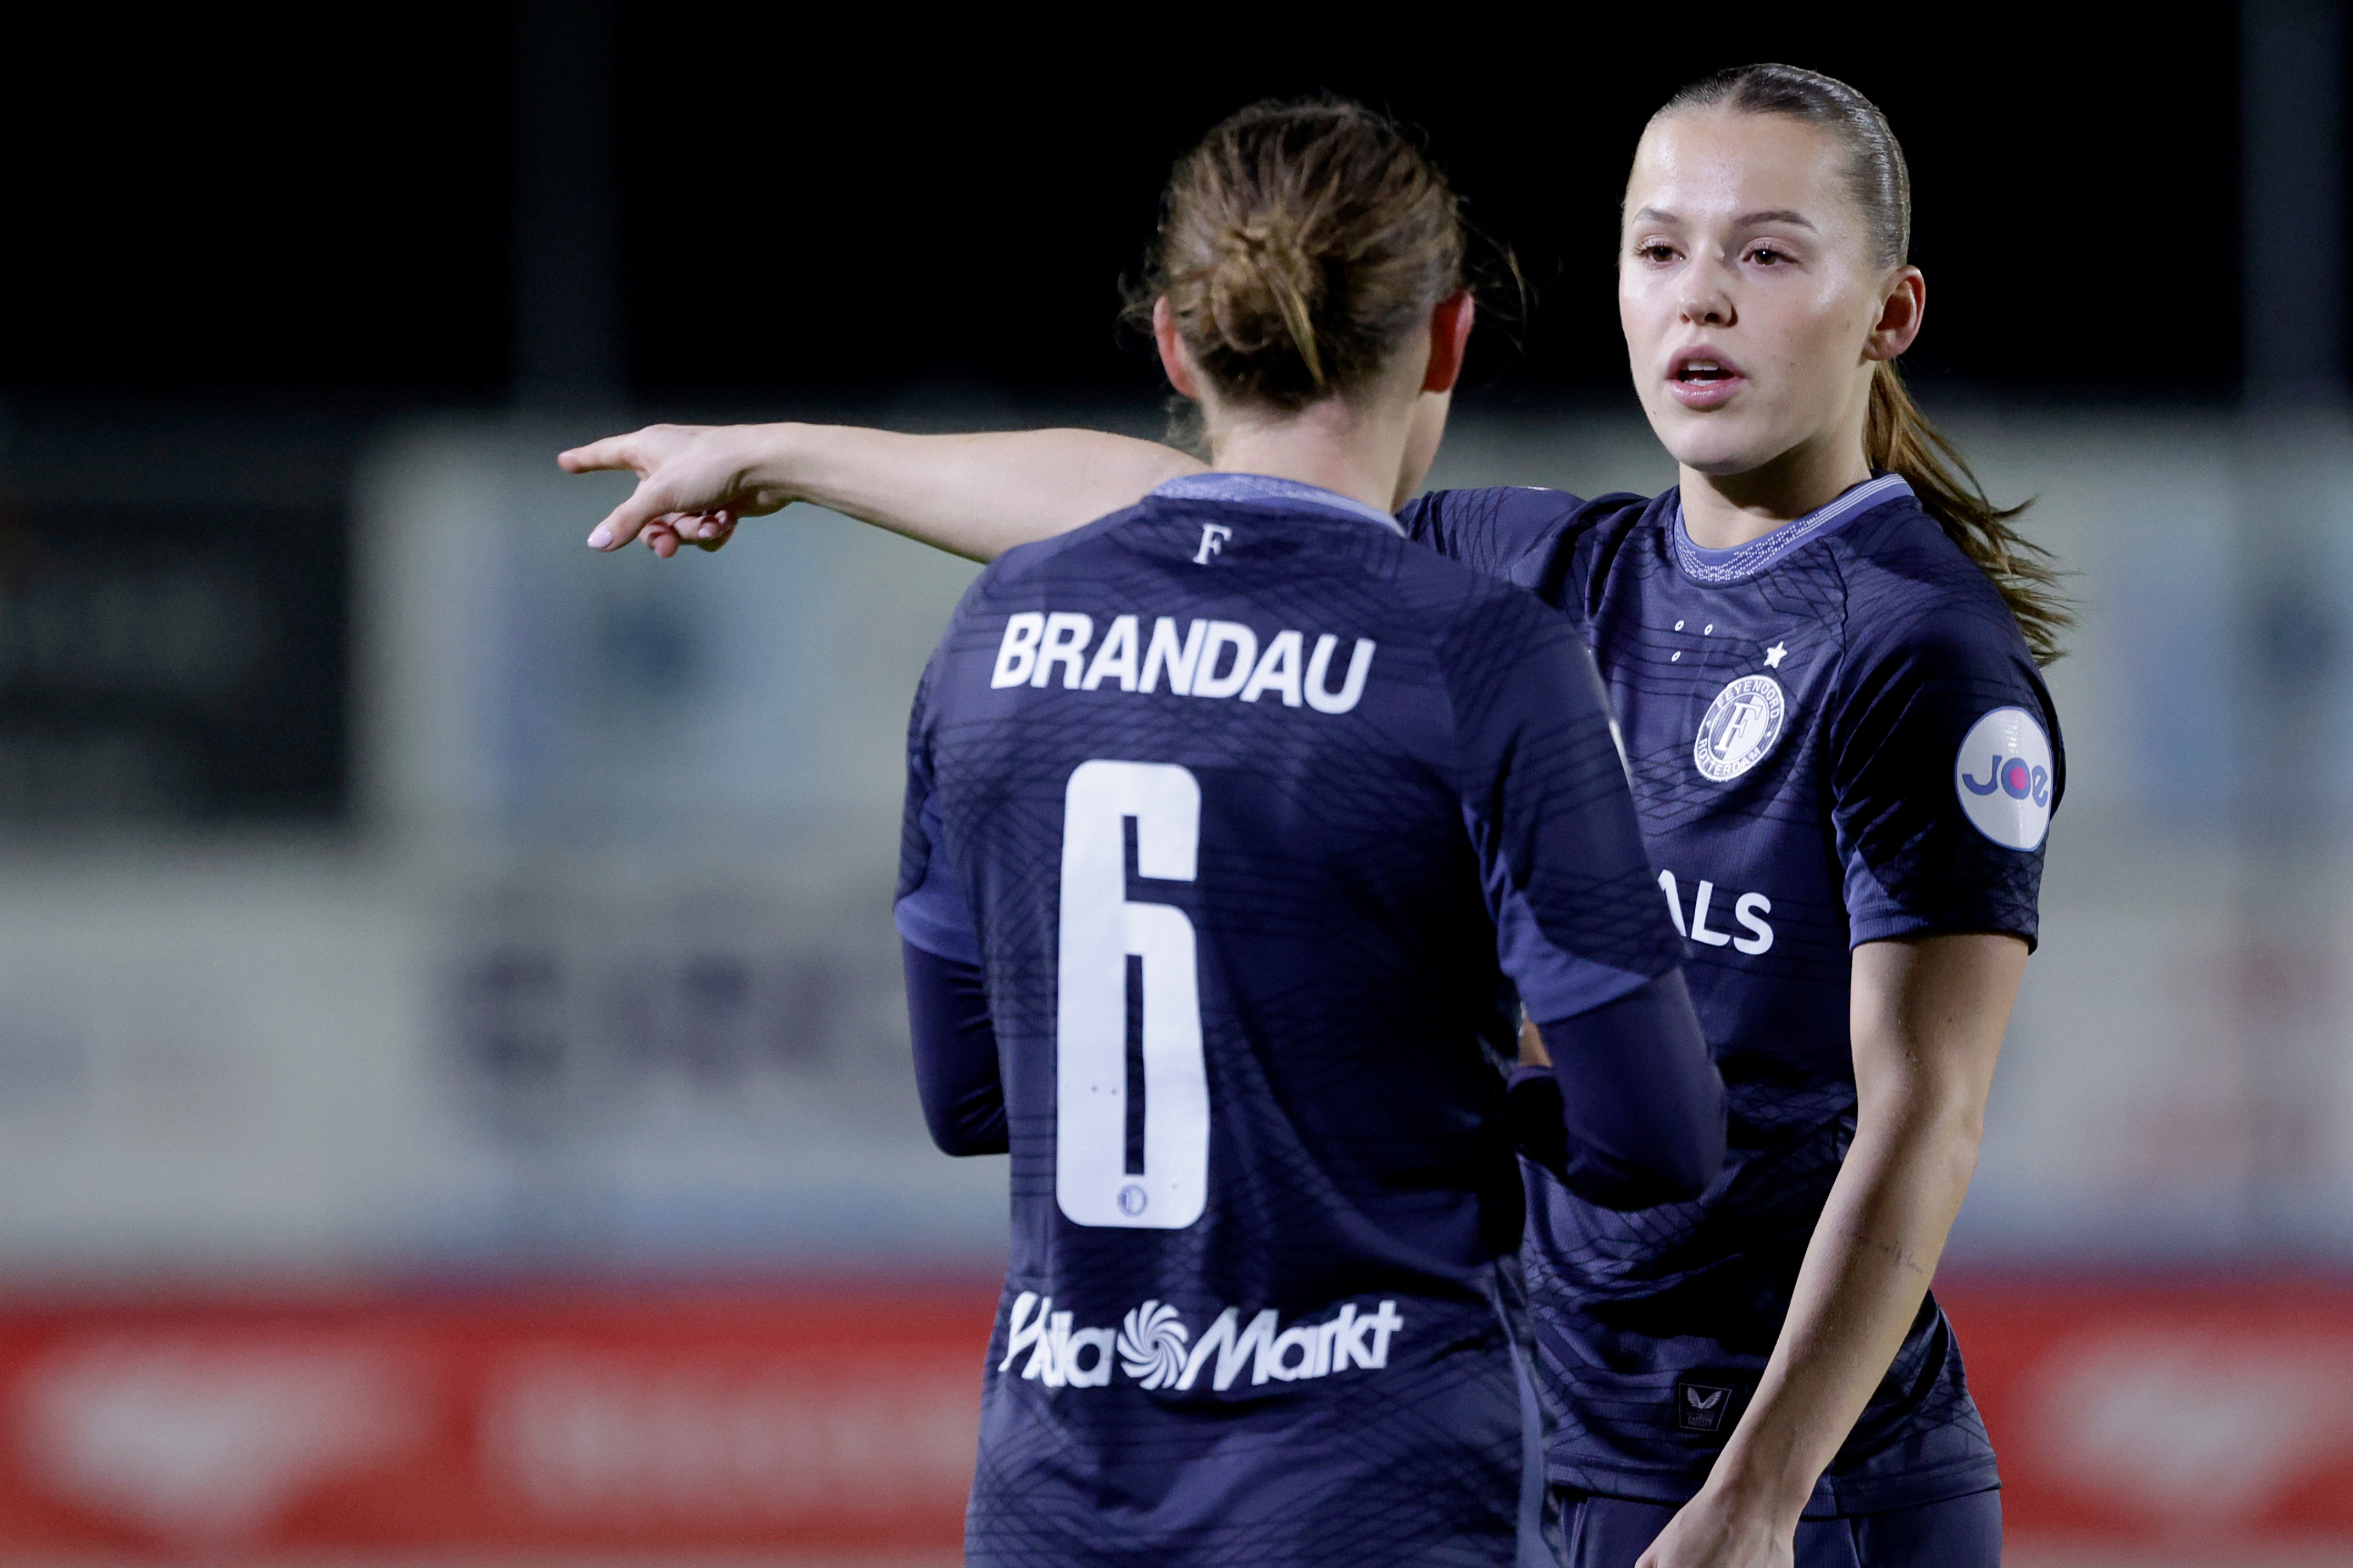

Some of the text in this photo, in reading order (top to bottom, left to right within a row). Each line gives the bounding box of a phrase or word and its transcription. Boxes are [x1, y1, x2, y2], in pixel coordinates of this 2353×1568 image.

[1192, 522, 1233, 565] F
[991, 611, 1376, 714] BRANDAU
[1715, 680, 1780, 719] FEYENOORD
[1713, 701, 1763, 752] F
[1698, 737, 1761, 776] ROTTERDAM
[1056, 759, 1210, 1229] 6
[1174, 1300, 1403, 1391] Markt
